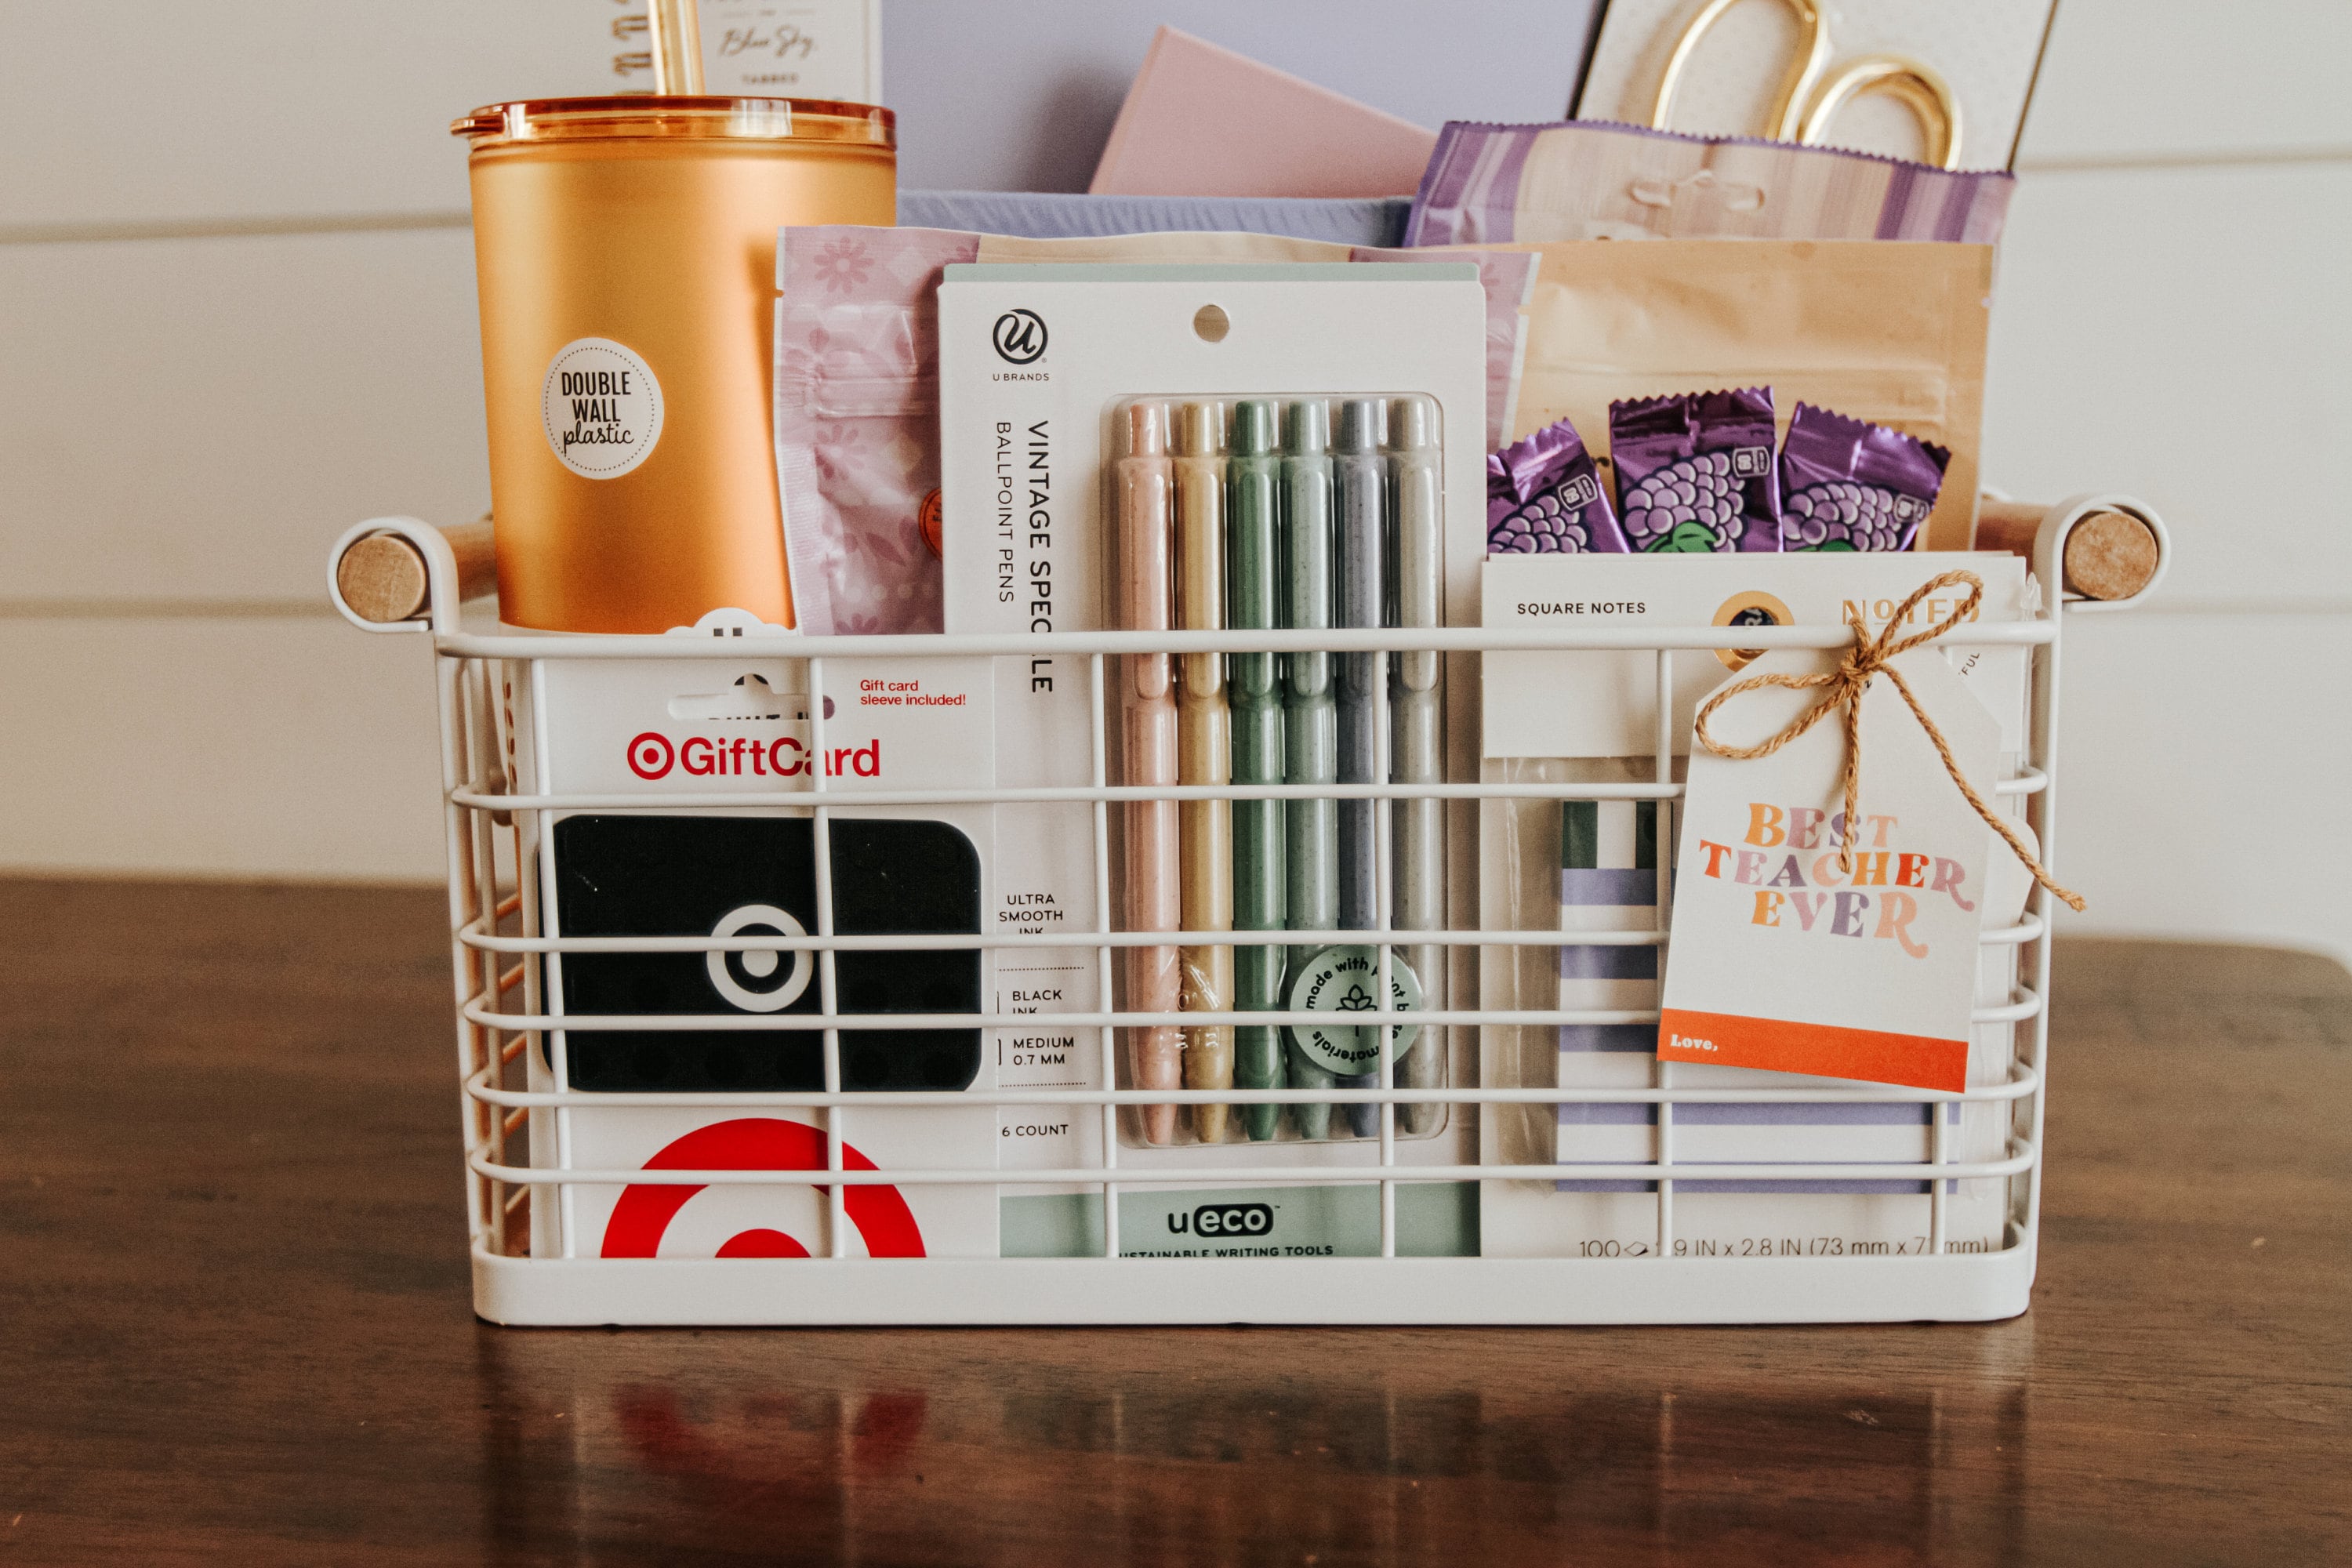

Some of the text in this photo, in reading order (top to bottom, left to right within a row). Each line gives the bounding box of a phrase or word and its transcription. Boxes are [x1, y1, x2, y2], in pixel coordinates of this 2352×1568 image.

[561, 372, 631, 396] DOUBLE
[572, 398, 621, 423] WALL
[563, 420, 634, 456] plastic
[996, 422, 1014, 602] BALLPOINT PENS
[1028, 420, 1053, 692] VINTAGE SPECLE
[1517, 602, 1646, 616] SQUARE NOTES
[860, 680, 919, 691] Gift card
[860, 694, 966, 705] sleeve included!
[1744, 803, 1898, 850] BEST
[1699, 839, 1975, 912] TEACHER
[1007, 894, 1055, 905] ULTRA
[1000, 910, 1063, 922] SMOOTH
[1751, 890, 1929, 959] EVER
[1335, 956, 1369, 973] with
[1012, 989, 1062, 1001] BLACK
[1305, 970, 1334, 1009] made
[1014, 1037, 1074, 1049] MEDIUM
[1312, 1031, 1380, 1063] materials
[1670, 1033, 1719, 1051] Love,
[1014, 1054, 1065, 1065] 0.7 MM
[1002, 1124, 1069, 1137] 6 COUNT
[1216, 1247, 1279, 1258] WRITING
[1285, 1245, 1333, 1256] TOOLS
[1580, 1240, 1621, 1257] 100
[1696, 1240, 1716, 1256] IN
[1725, 1243, 1734, 1256] x
[1742, 1239, 1772, 1256] 2.8
[1781, 1239, 1802, 1255] IN
[1810, 1238, 1843, 1255] (73
[1852, 1242, 1889, 1255] mm
[1896, 1242, 1907, 1255] x
